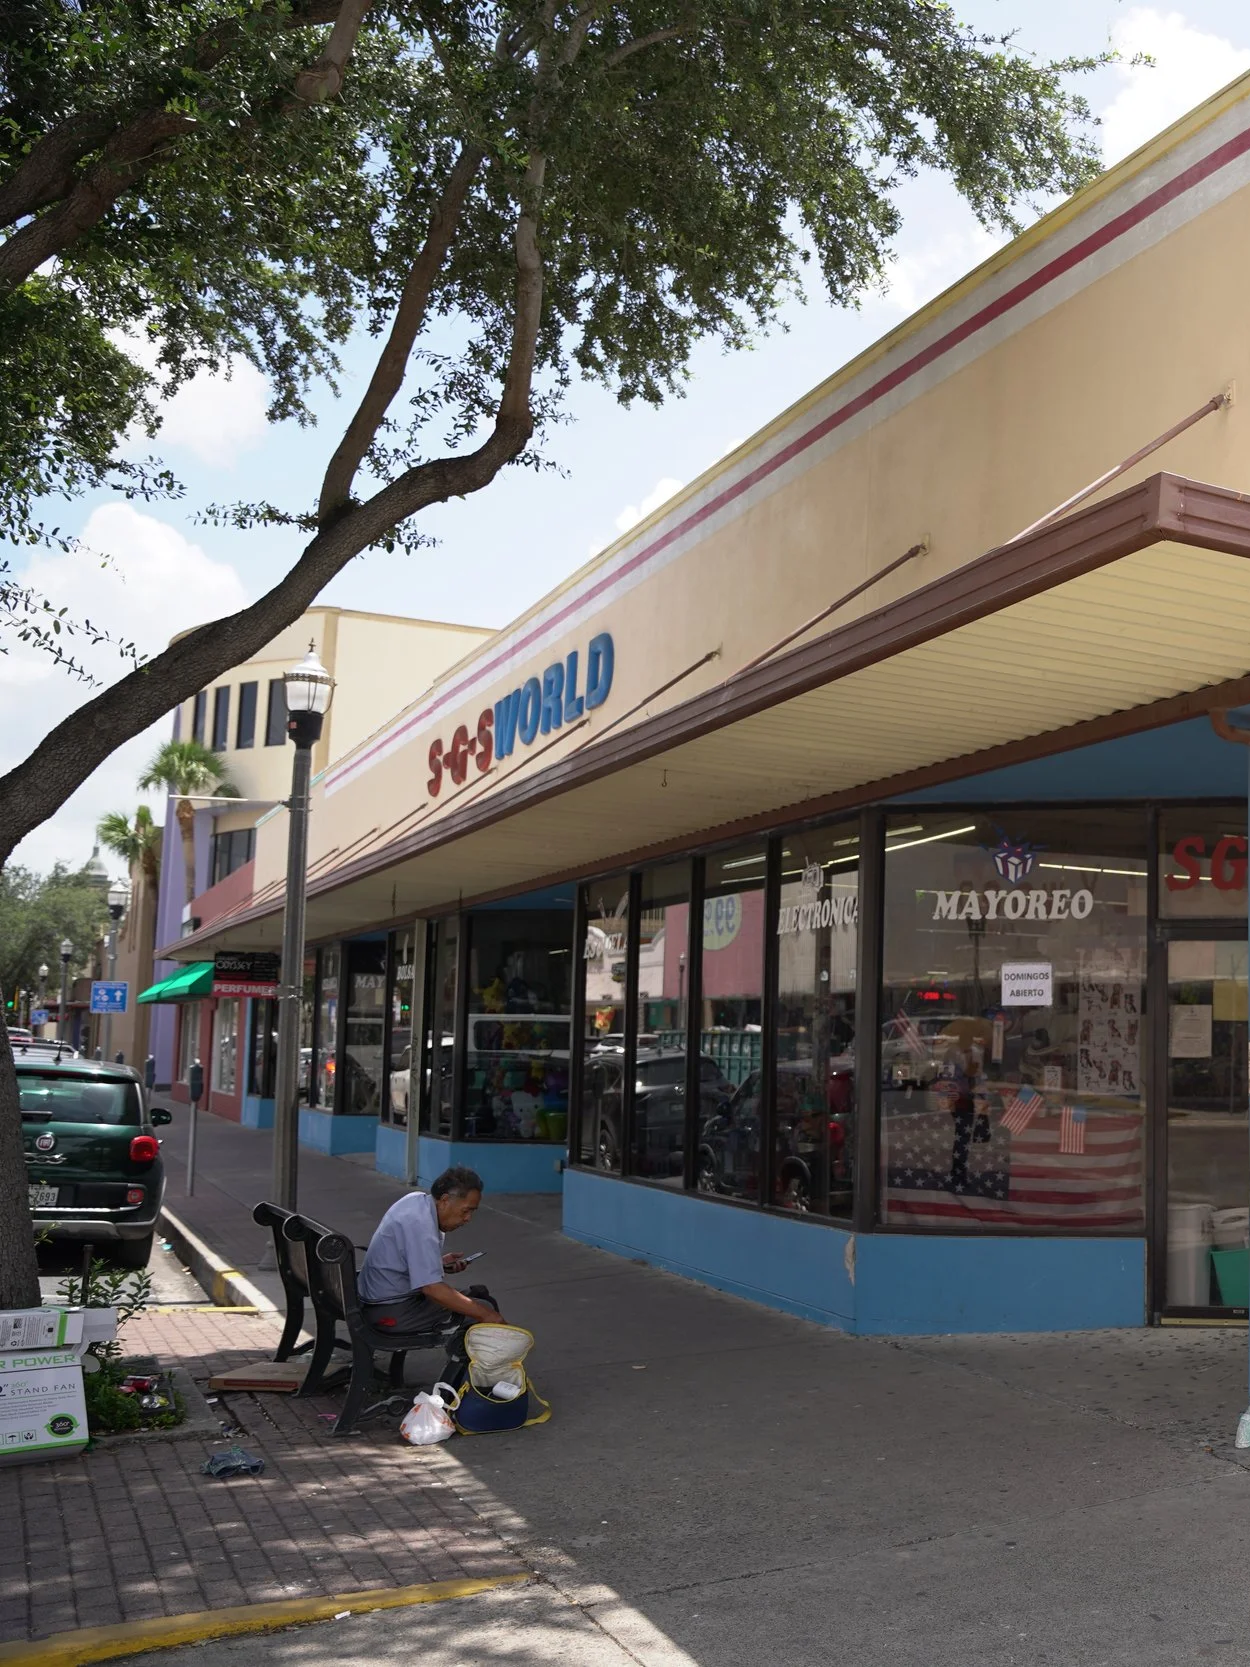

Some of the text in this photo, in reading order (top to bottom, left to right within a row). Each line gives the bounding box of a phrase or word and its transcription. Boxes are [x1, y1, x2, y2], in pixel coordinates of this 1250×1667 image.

[494, 632, 615, 760] WORLD
[1165, 836, 1249, 891] SG
[932, 889, 1094, 921] MAYOREO
[1004, 972, 1050, 981] DOMINGOS
[1009, 989, 1044, 998] ABIERTO
[12, 1354, 76, 1369] POWER
[10, 1386, 49, 1396] STAND
[54, 1383, 76, 1391] FAN
